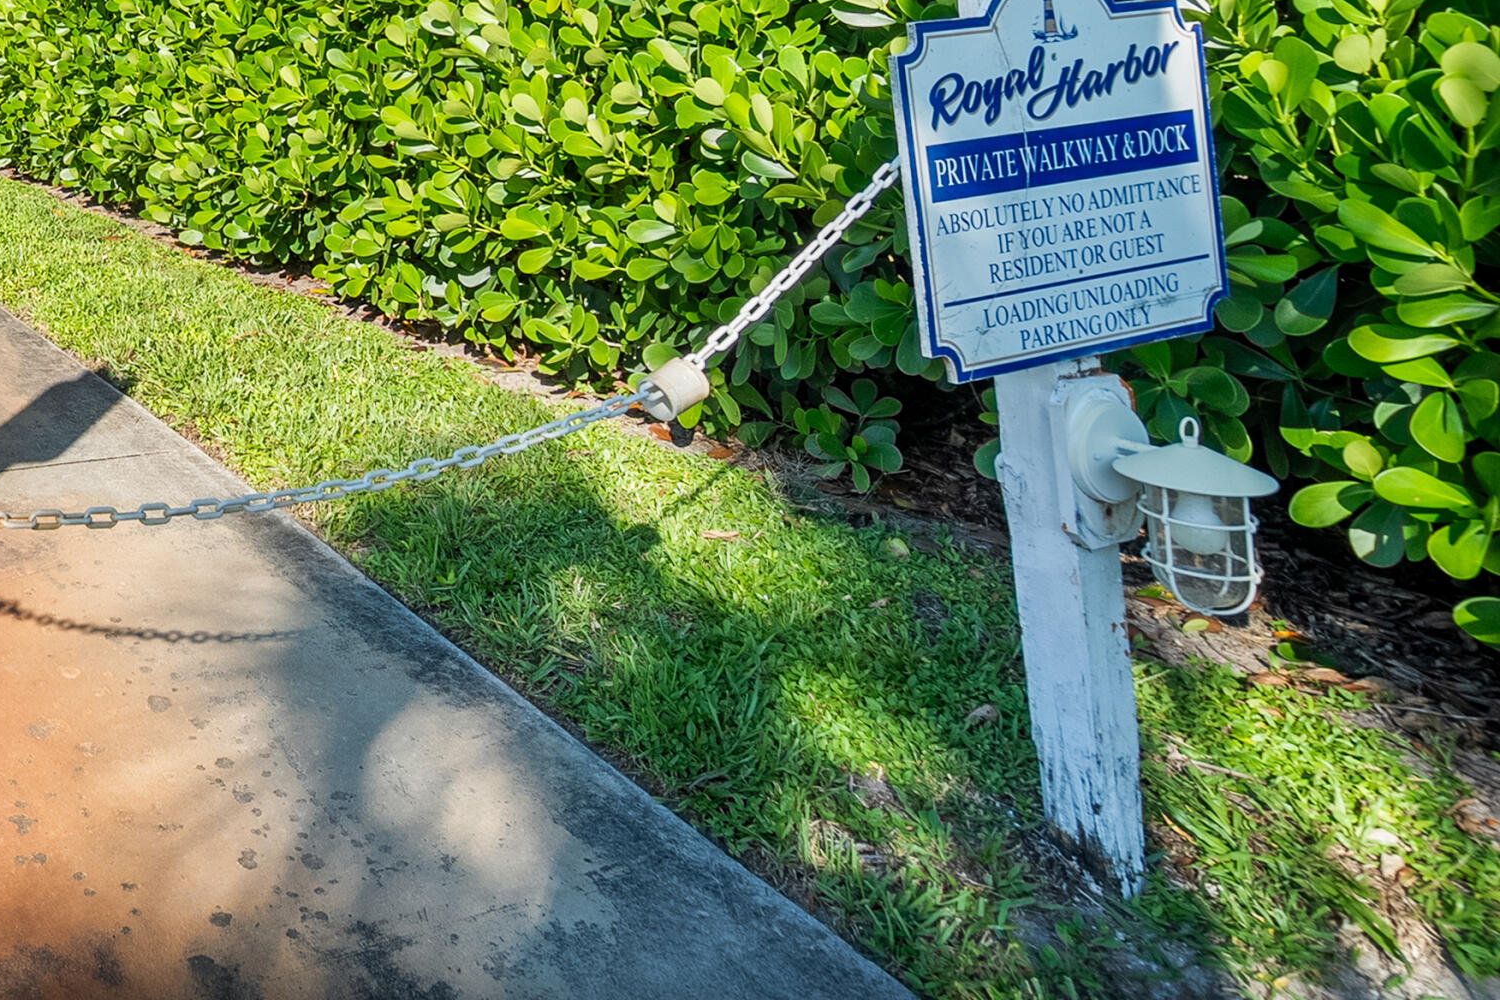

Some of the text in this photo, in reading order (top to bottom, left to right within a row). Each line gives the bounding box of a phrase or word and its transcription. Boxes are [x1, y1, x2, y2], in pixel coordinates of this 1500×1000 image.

[929, 40, 1180, 132] Royal Harbor
[933, 123, 1191, 188] PRIVATE WALKWAY & DOCK
[936, 174, 1202, 236] ABSOLUTELY NO ADMITTANCE
[998, 209, 1153, 254] IF YOU ARE NOT A
[989, 233, 1165, 284] RESIDENT OR GUEST
[983, 272, 1180, 329] LOADING/UNLOADING
[1019, 305, 1153, 350] PARKING ONLY
